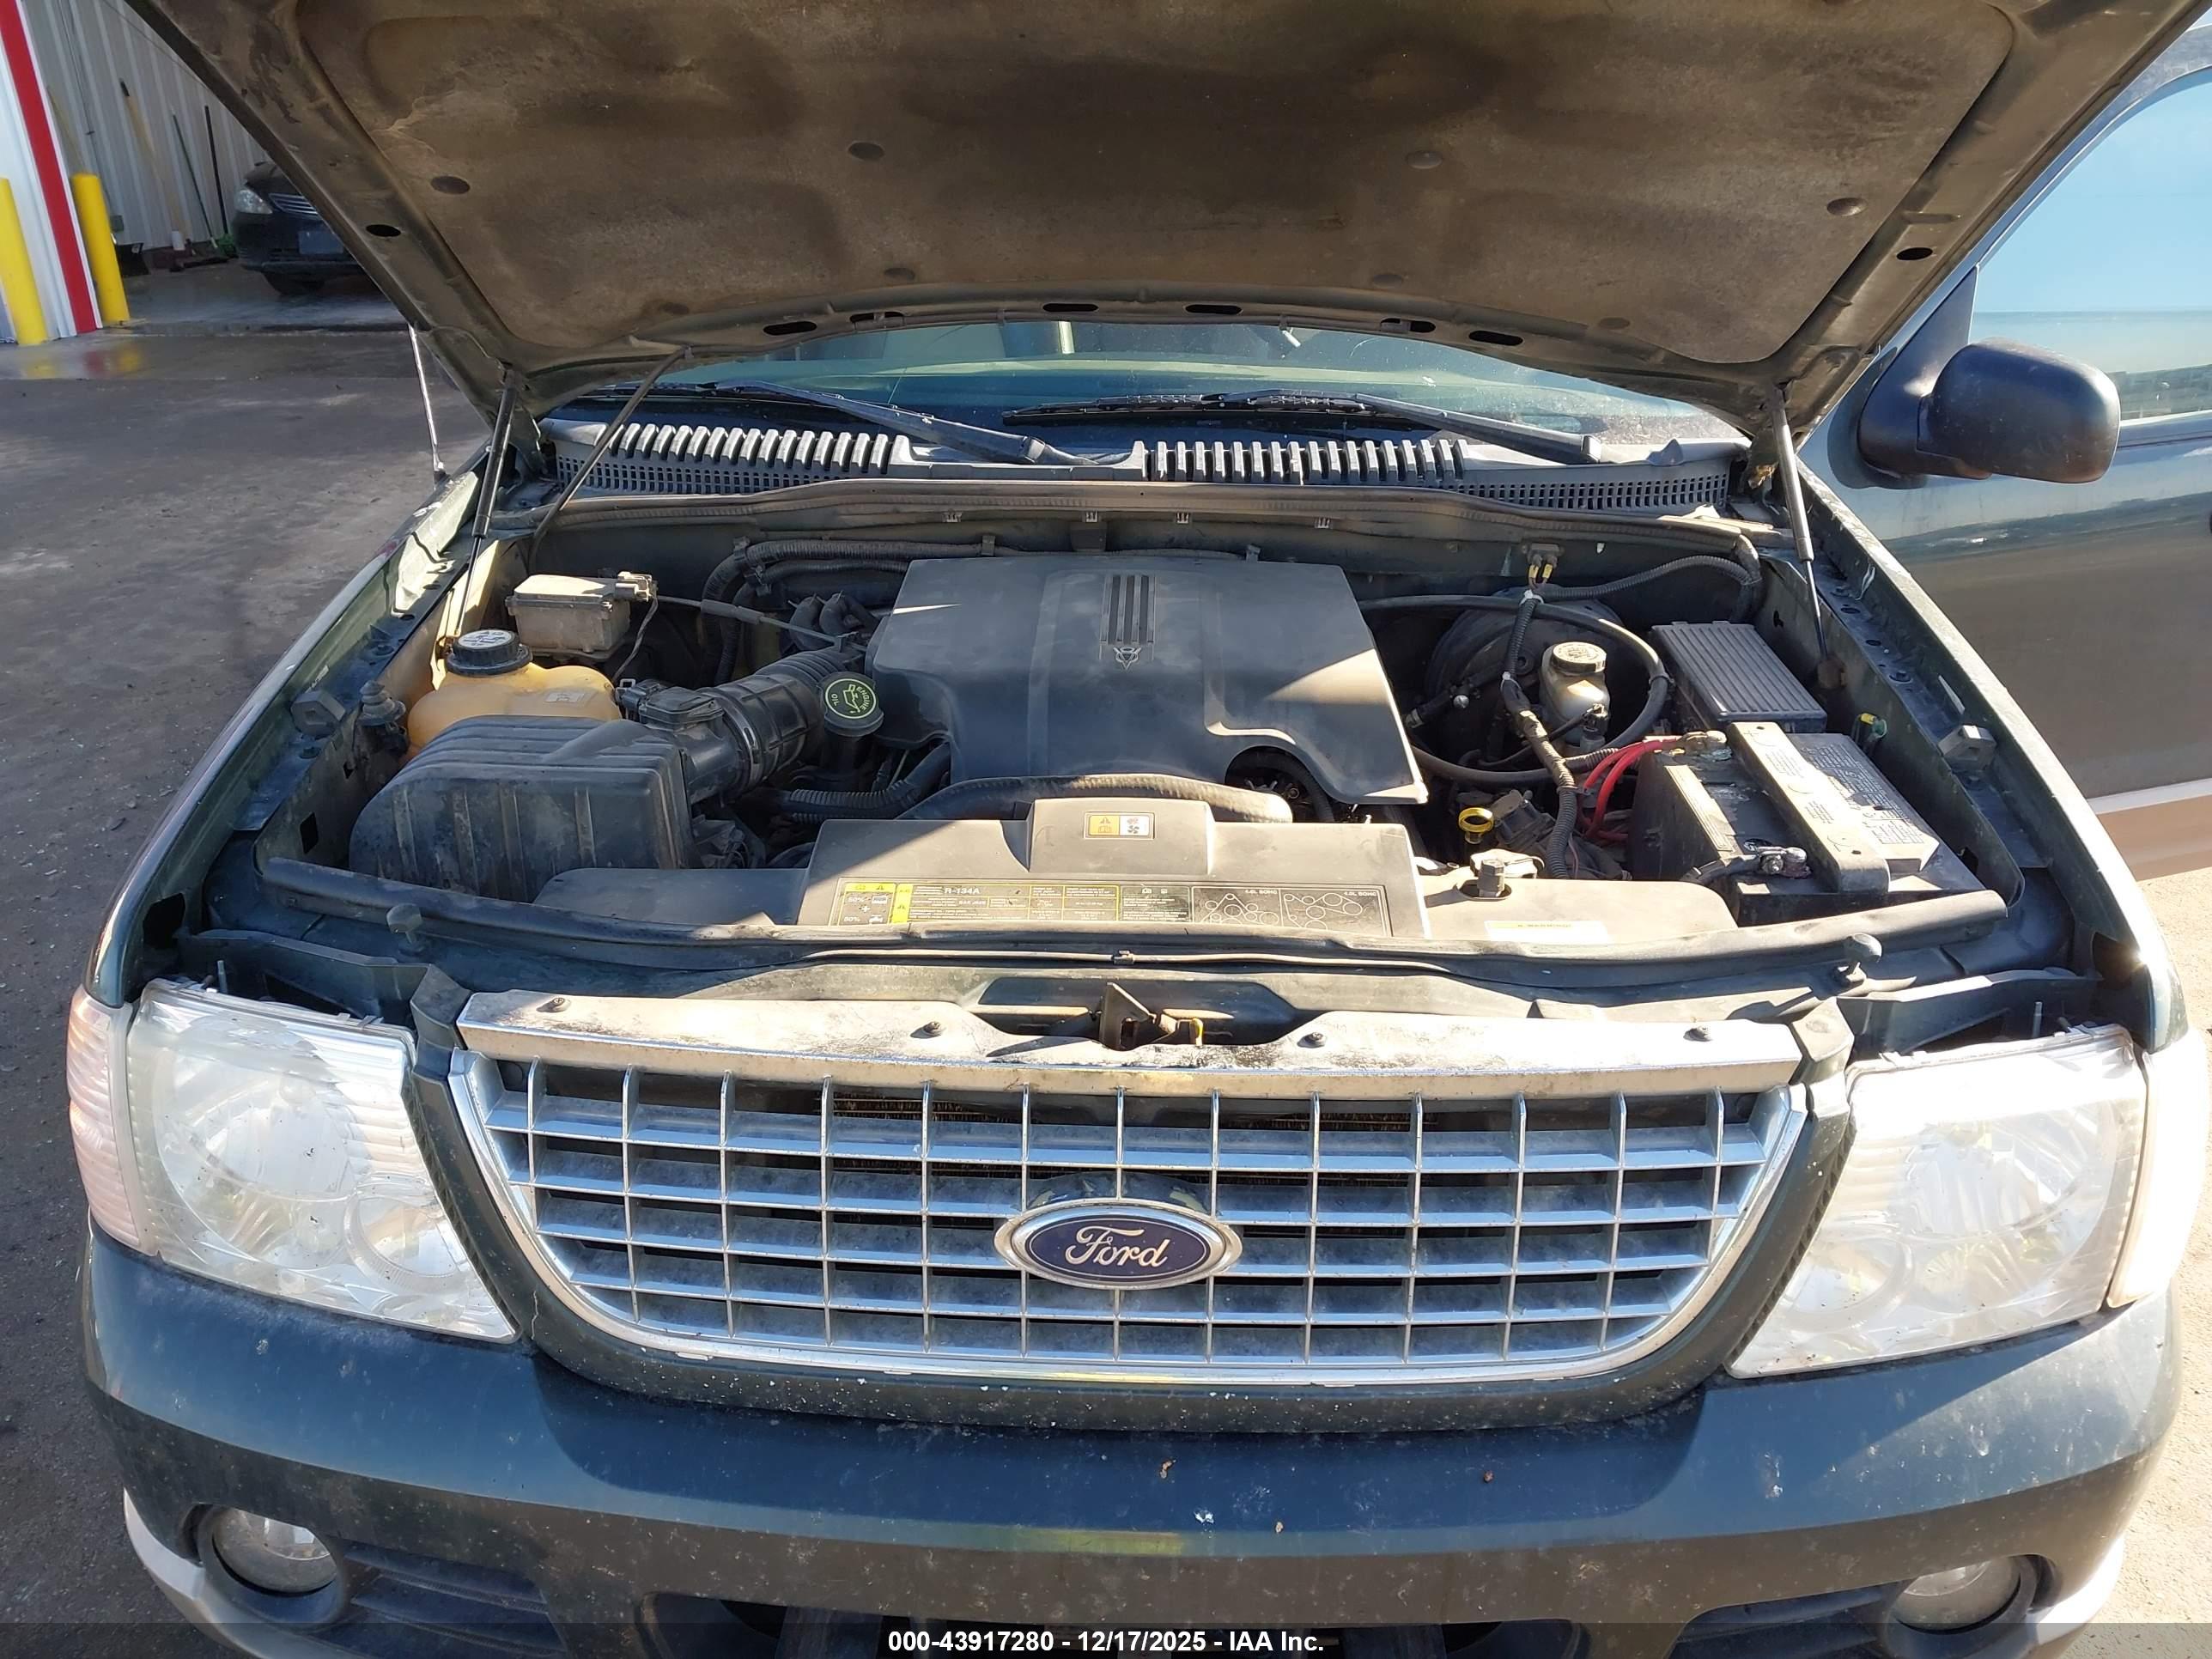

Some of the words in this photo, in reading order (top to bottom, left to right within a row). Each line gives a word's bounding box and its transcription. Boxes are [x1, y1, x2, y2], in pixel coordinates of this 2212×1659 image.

[830, 693, 841, 707] OIL
[855, 685, 872, 711] ENGINE
[1065, 1224, 1170, 1267] Ford
